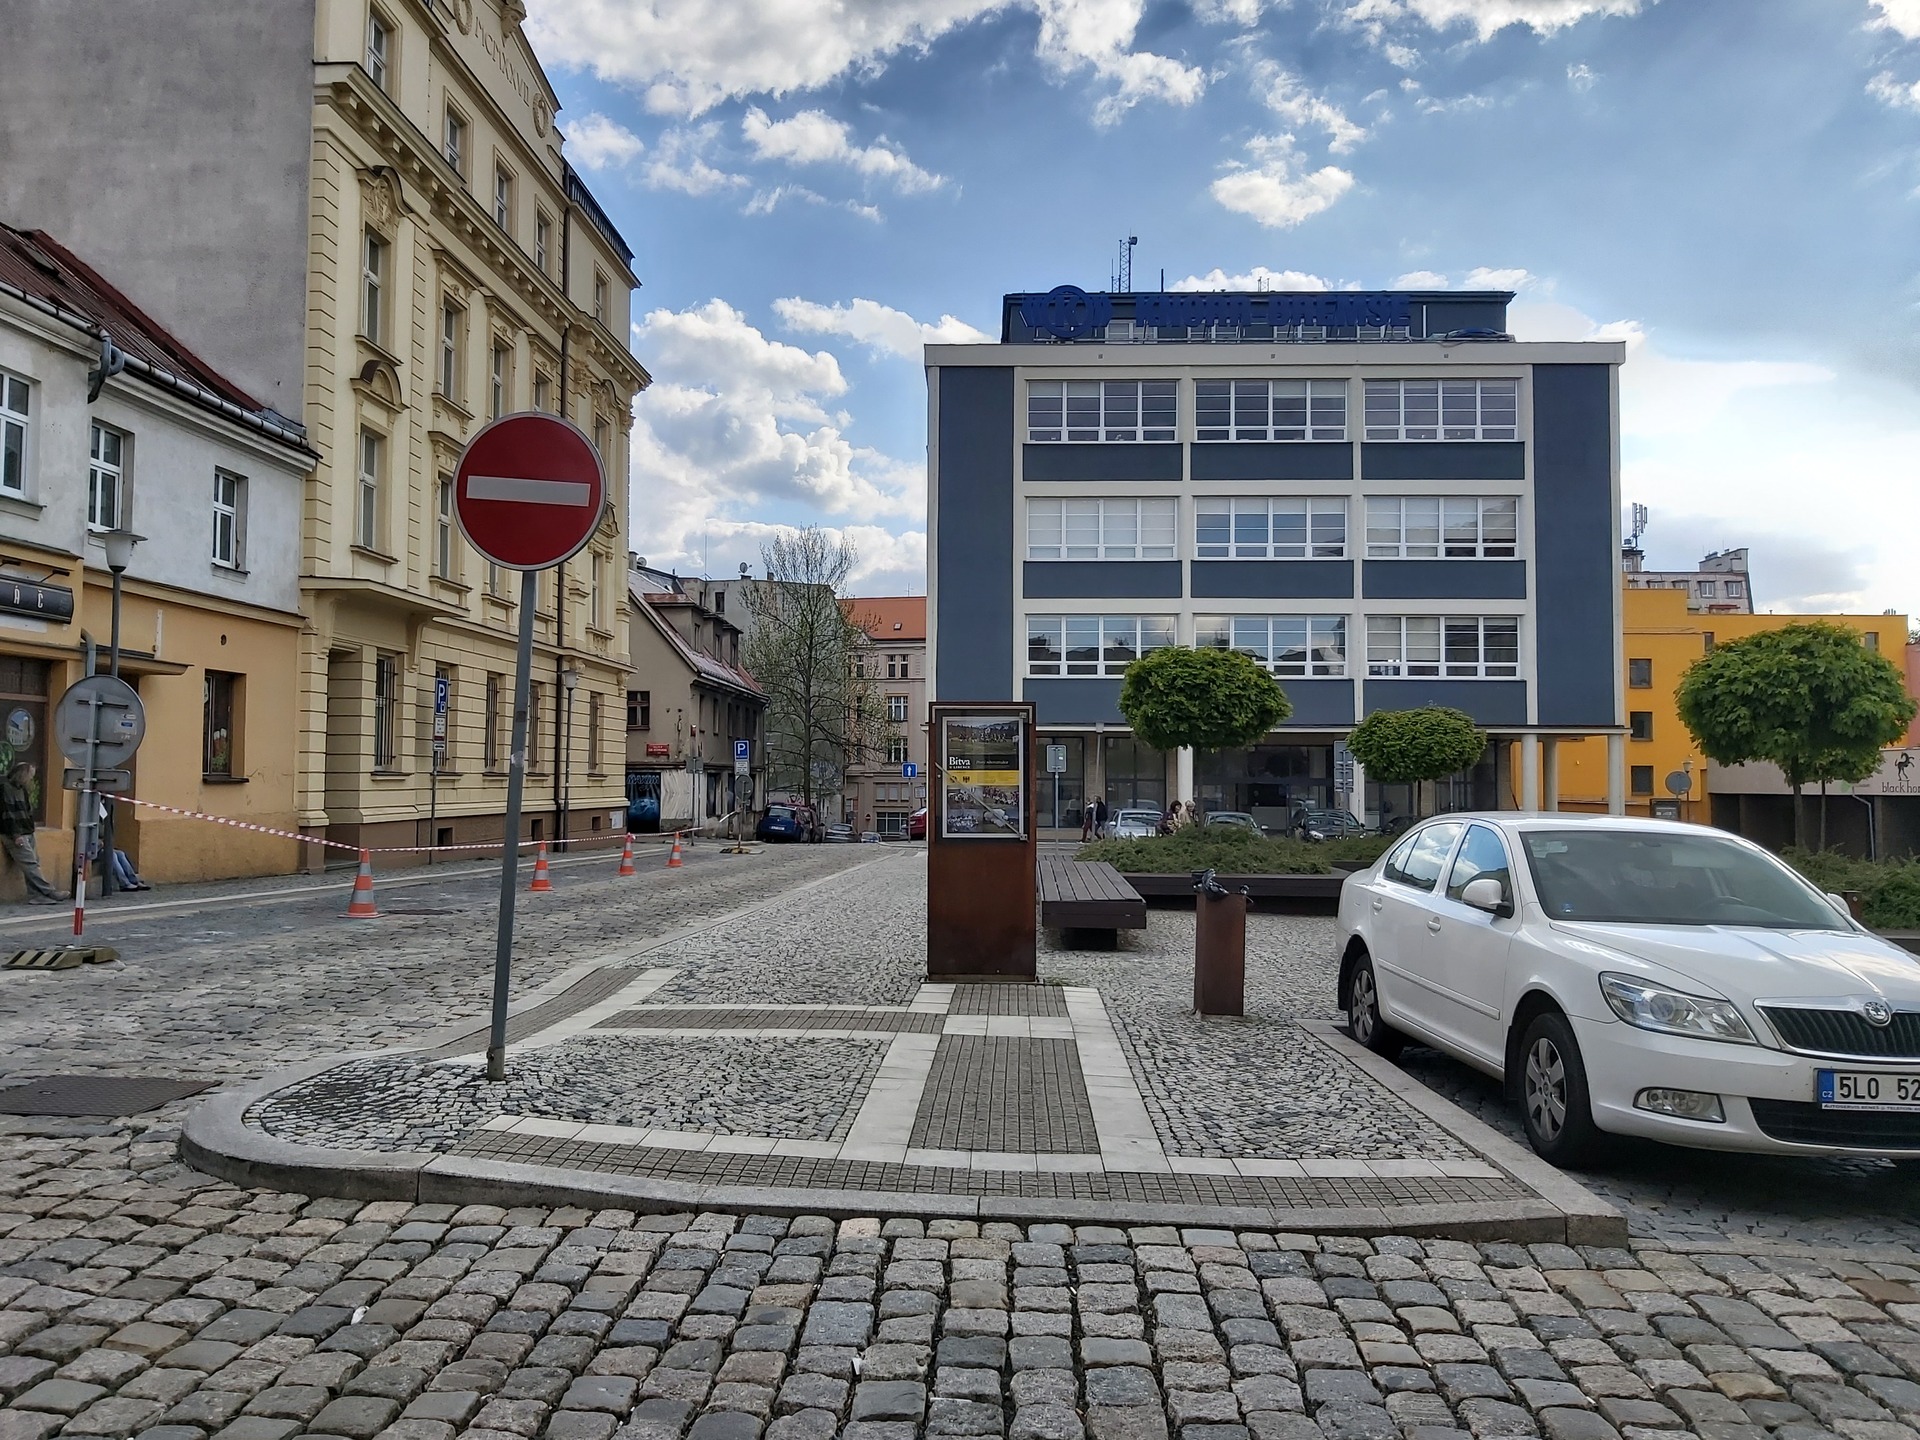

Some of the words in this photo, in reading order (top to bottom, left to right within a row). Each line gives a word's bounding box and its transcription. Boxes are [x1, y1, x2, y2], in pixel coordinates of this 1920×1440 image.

[475, 16, 530, 108] MCMXXVII
[438, 684, 446, 704] P
[737, 743, 746, 755] P
[949, 756, 971, 766] Bitva
[627, 774, 660, 785] MAXIM
[1881, 781, 1905, 793] black
[1822, 1090, 1833, 1098] CZ
[1839, 1076, 1880, 1099] 5L0
[1897, 1078, 1920, 1100] 52
